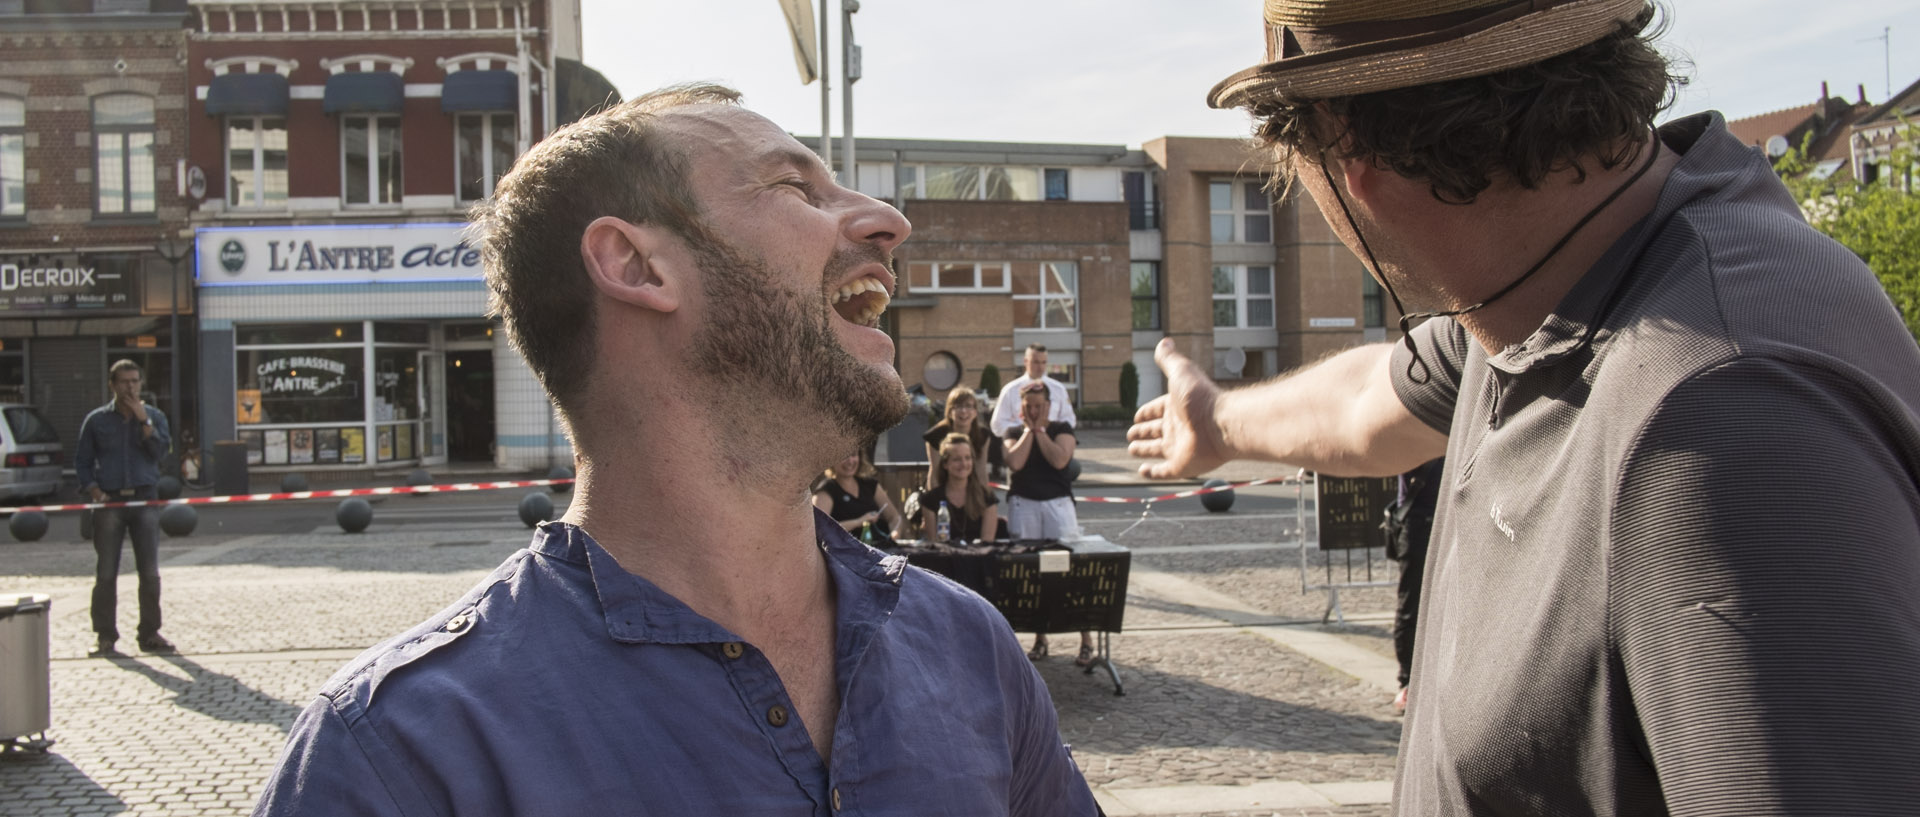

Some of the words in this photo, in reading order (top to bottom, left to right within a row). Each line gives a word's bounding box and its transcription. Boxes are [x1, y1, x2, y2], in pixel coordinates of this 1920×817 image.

[1, 264, 96, 290] DECROIX
[1323, 479, 1368, 495] Ballet
[1350, 493, 1369, 508] du
[1328, 508, 1370, 524] Nord
[1092, 575, 1117, 591] du
[1063, 590, 1116, 608] Nord
